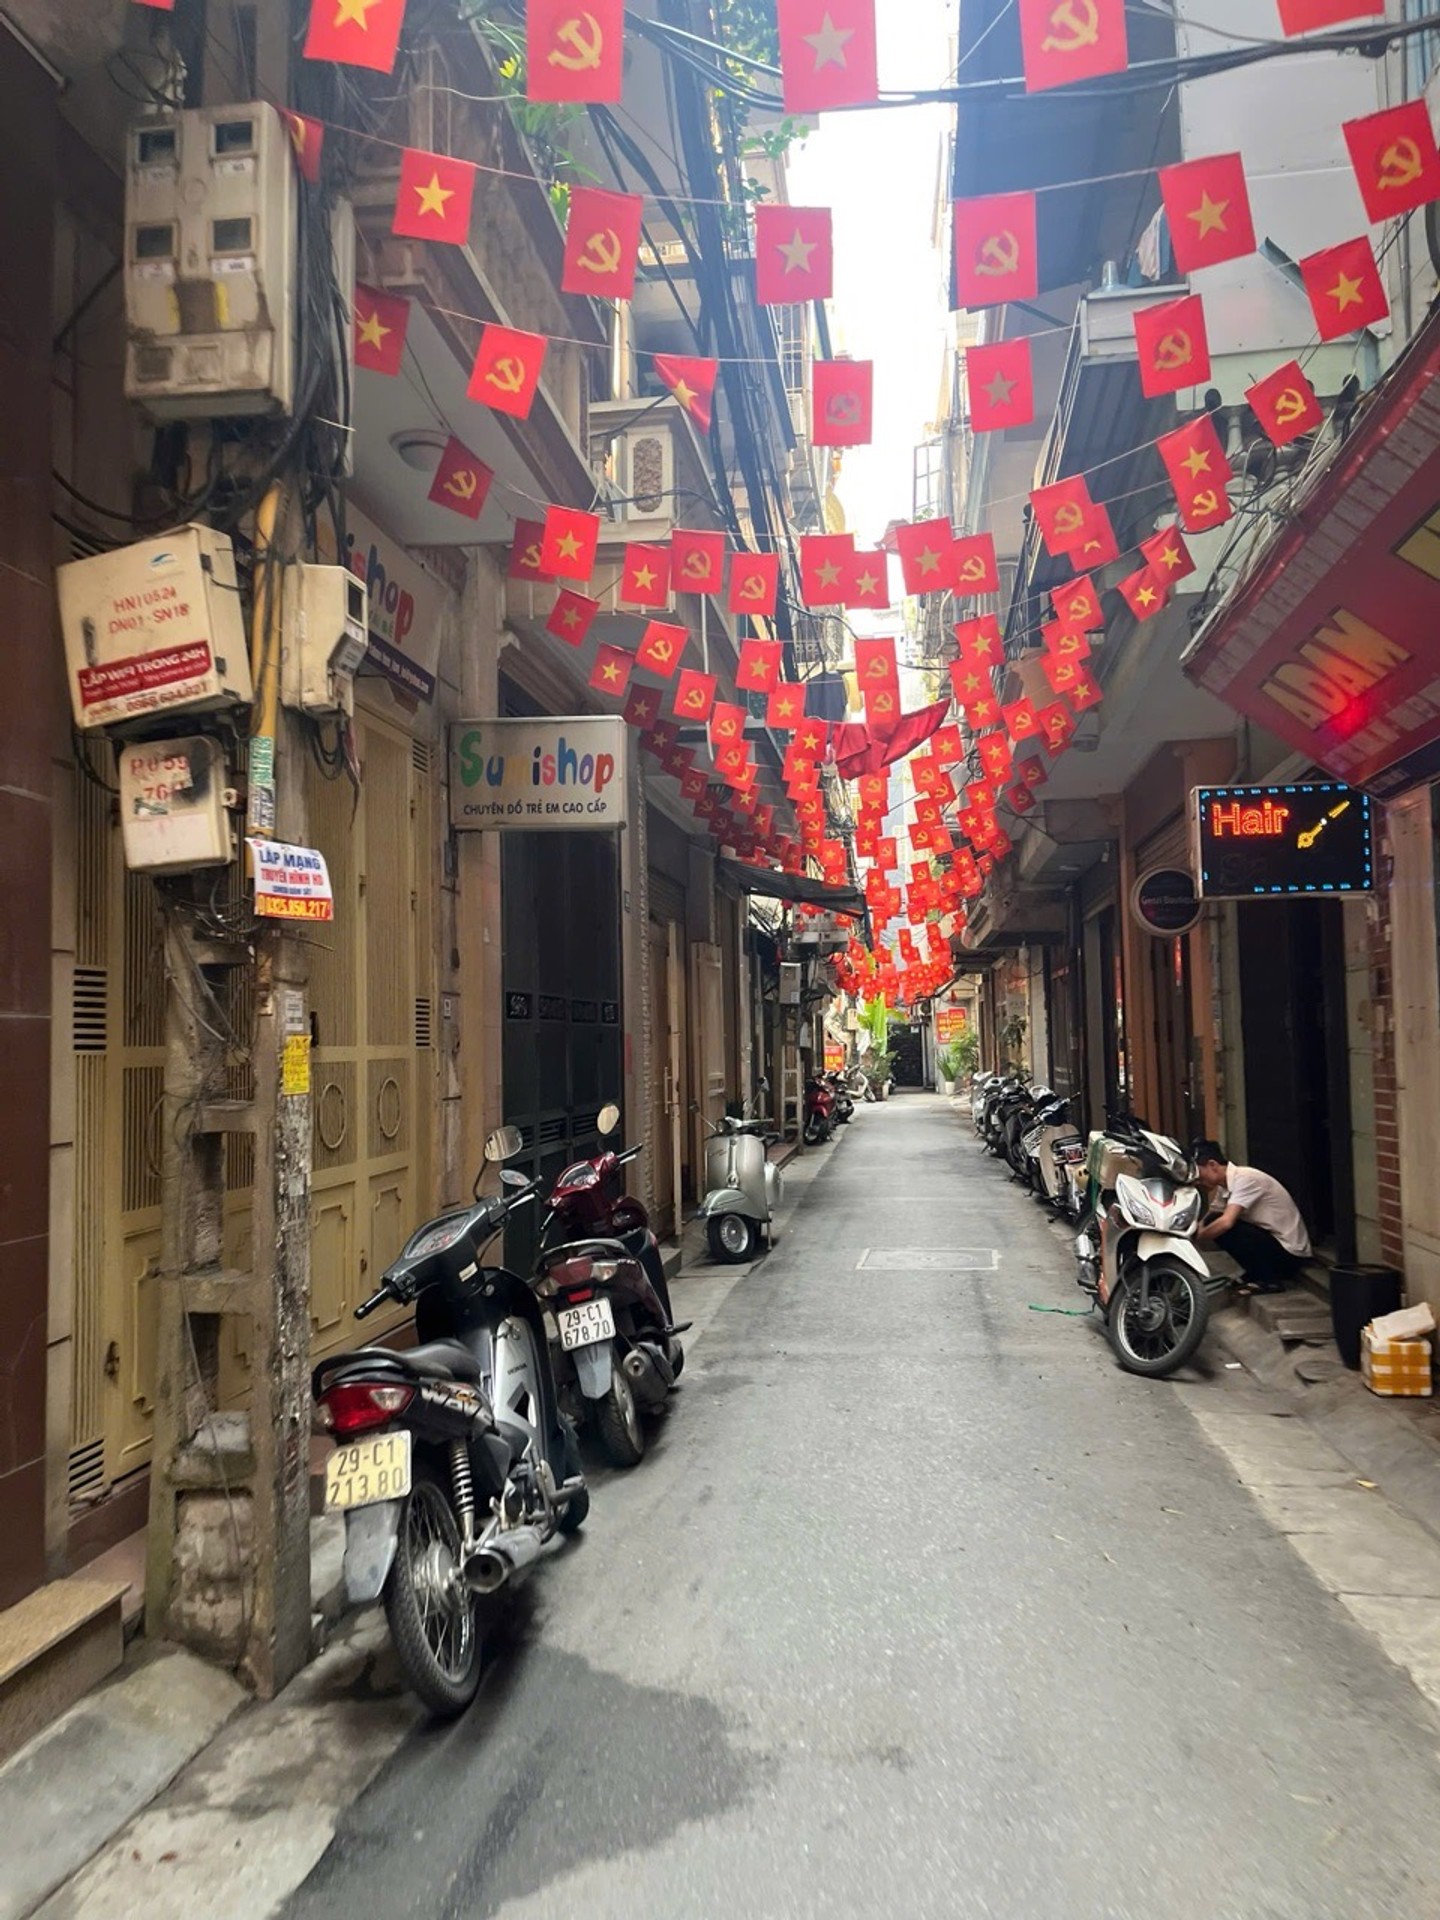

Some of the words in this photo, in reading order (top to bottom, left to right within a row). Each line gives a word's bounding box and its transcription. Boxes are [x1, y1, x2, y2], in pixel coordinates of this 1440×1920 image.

[136, 654, 181, 673] TRONG
[1261, 606, 1412, 731] ADAM
[459, 730, 615, 793] Sumishop
[463, 801, 504, 816] CHUYÊN
[546, 802, 561, 813] EM
[562, 802, 584, 814] CAO
[586, 798, 607, 813] CẤP
[1212, 800, 1290, 836] Hair
[564, 1319, 612, 1347] 678.70
[565, 1303, 603, 1328] 29-C1
[337, 1439, 396, 1477] 29-C1
[330, 1467, 404, 1508] 213.80
